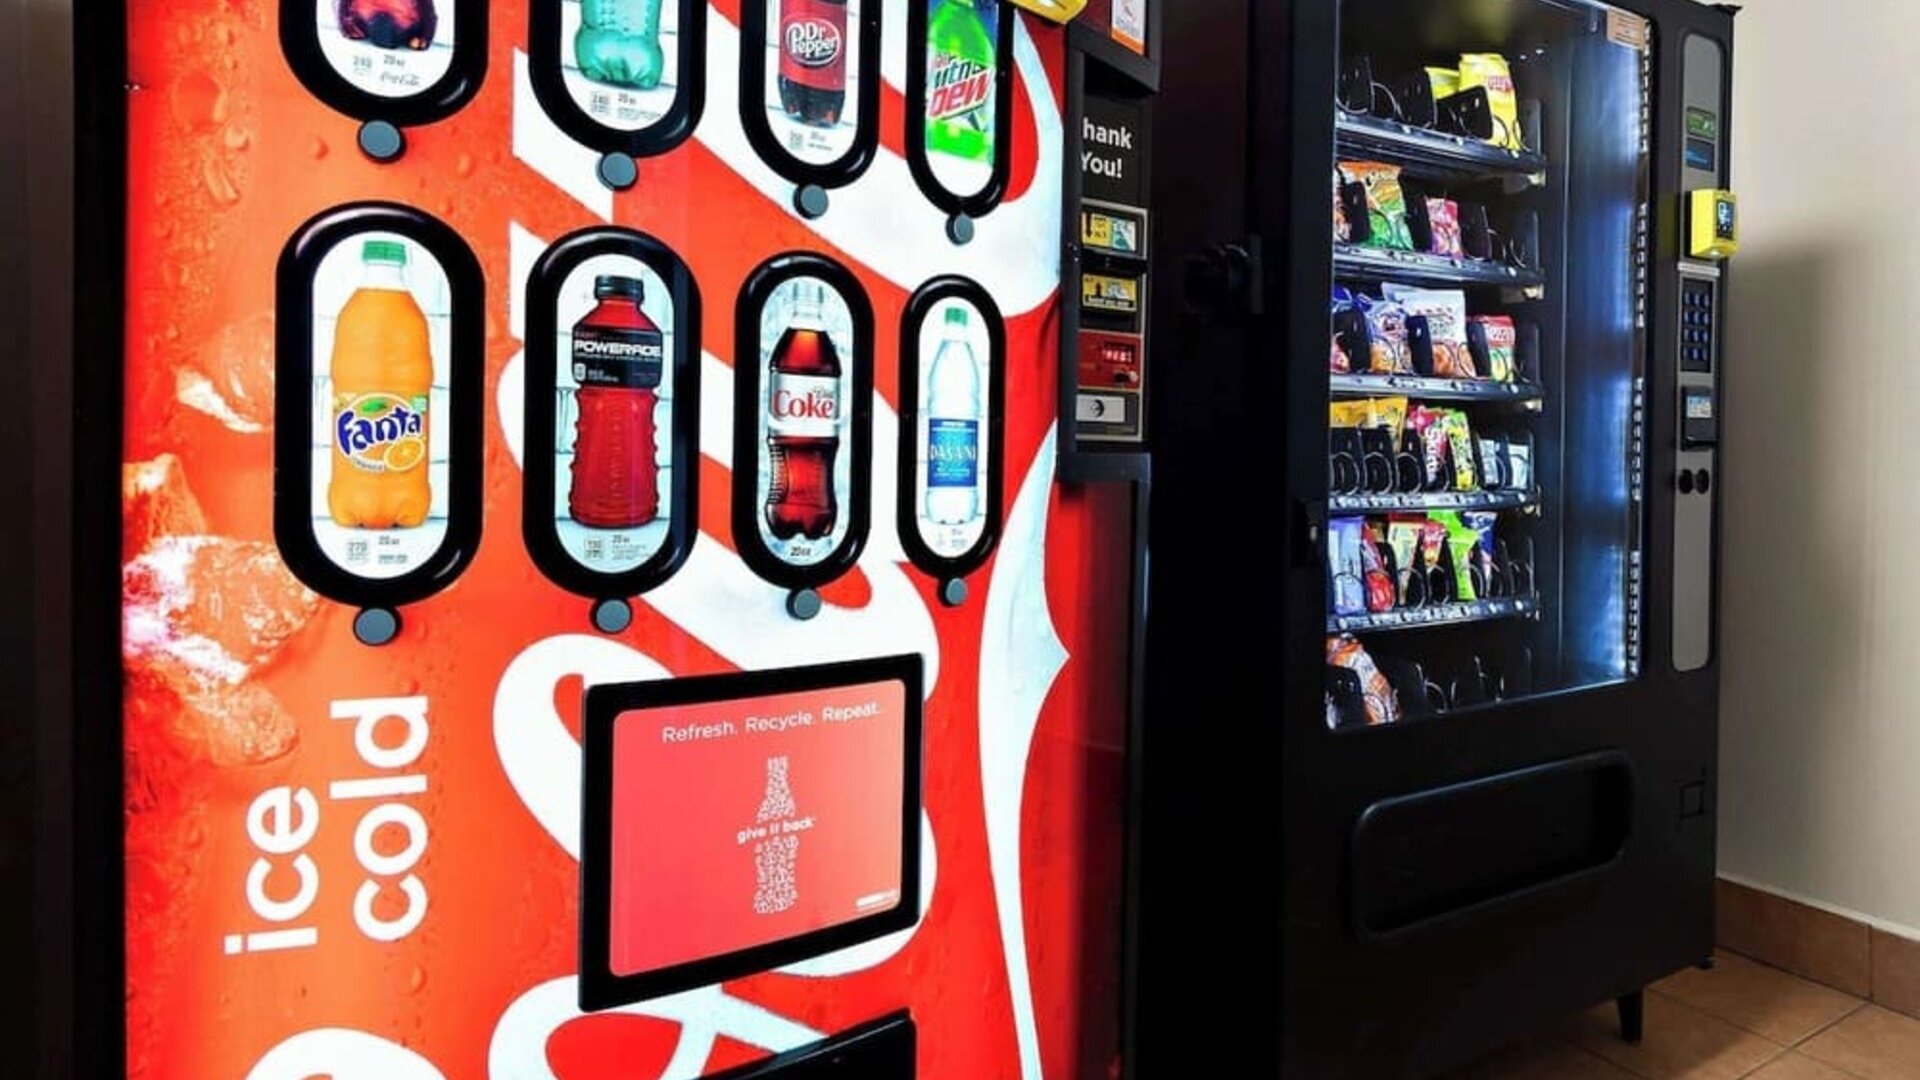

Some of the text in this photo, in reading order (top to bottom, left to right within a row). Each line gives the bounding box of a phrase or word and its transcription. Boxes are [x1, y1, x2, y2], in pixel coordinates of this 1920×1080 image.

[786, 22, 839, 58] Pepper
[804, 21, 827, 40] Dr
[1082, 116, 1132, 149] hank
[1080, 151, 1122, 178] You!
[573, 340, 662, 358] POWERADE
[772, 389, 835, 420] Coke
[336, 406, 423, 456] Fanta
[661, 702, 881, 743] Refresh. Recycle. Repeat.
[328, 694, 429, 942] cold
[736, 826, 767, 845] give
[223, 786, 320, 956] ice
